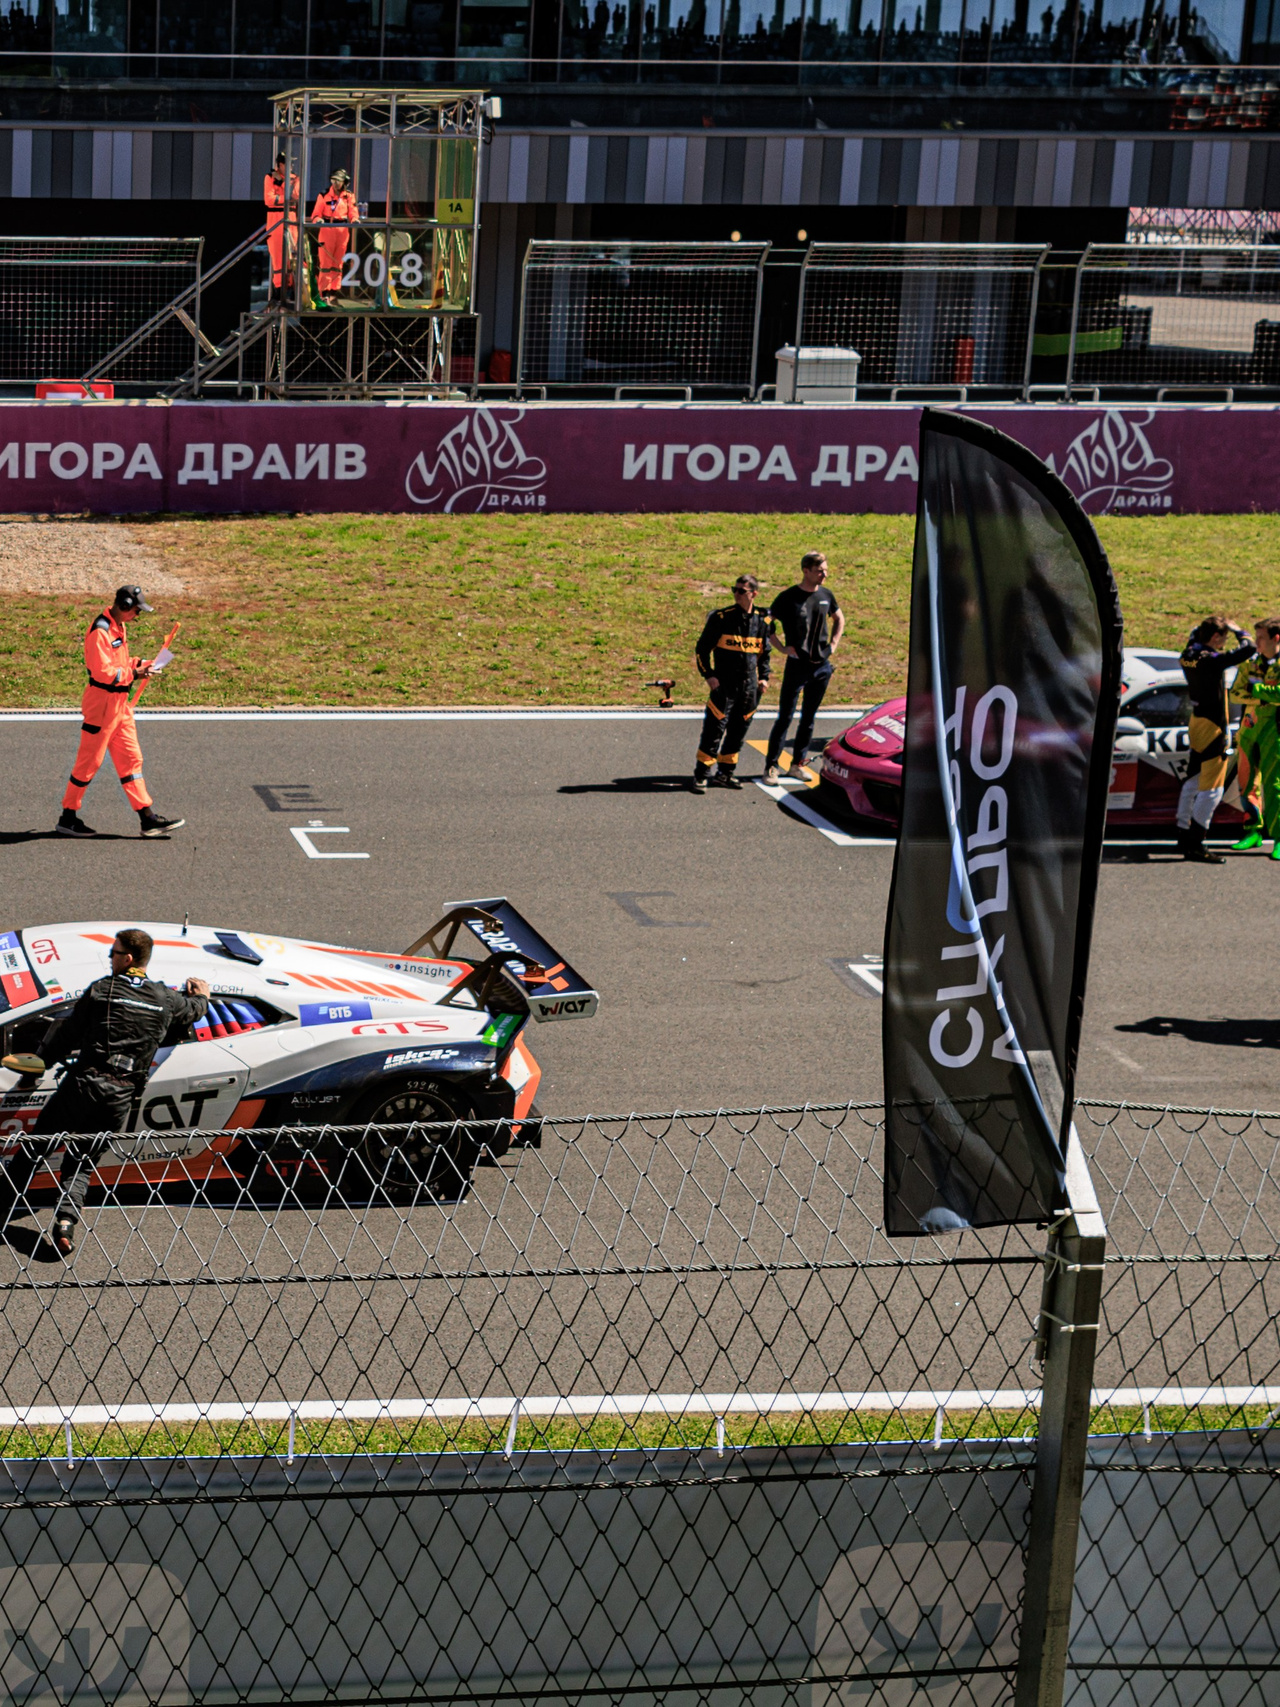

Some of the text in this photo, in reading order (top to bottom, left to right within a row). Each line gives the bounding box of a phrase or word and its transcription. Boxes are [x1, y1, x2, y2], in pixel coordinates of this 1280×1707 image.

[448, 202, 463, 213] 1A
[341, 252, 422, 287] 20.8
[177, 443, 366, 486] ДРАЙВ
[623, 444, 919, 487] ИГОРА ДРА
[486, 492, 547, 507] ДРАЙВ
[1113, 494, 1173, 508] ДРАЙВ
[31, 939, 61, 964] GTS
[403, 963, 453, 978] insight
[328, 1005, 352, 1020] ВТБ
[351, 1020, 449, 1035] GTS
